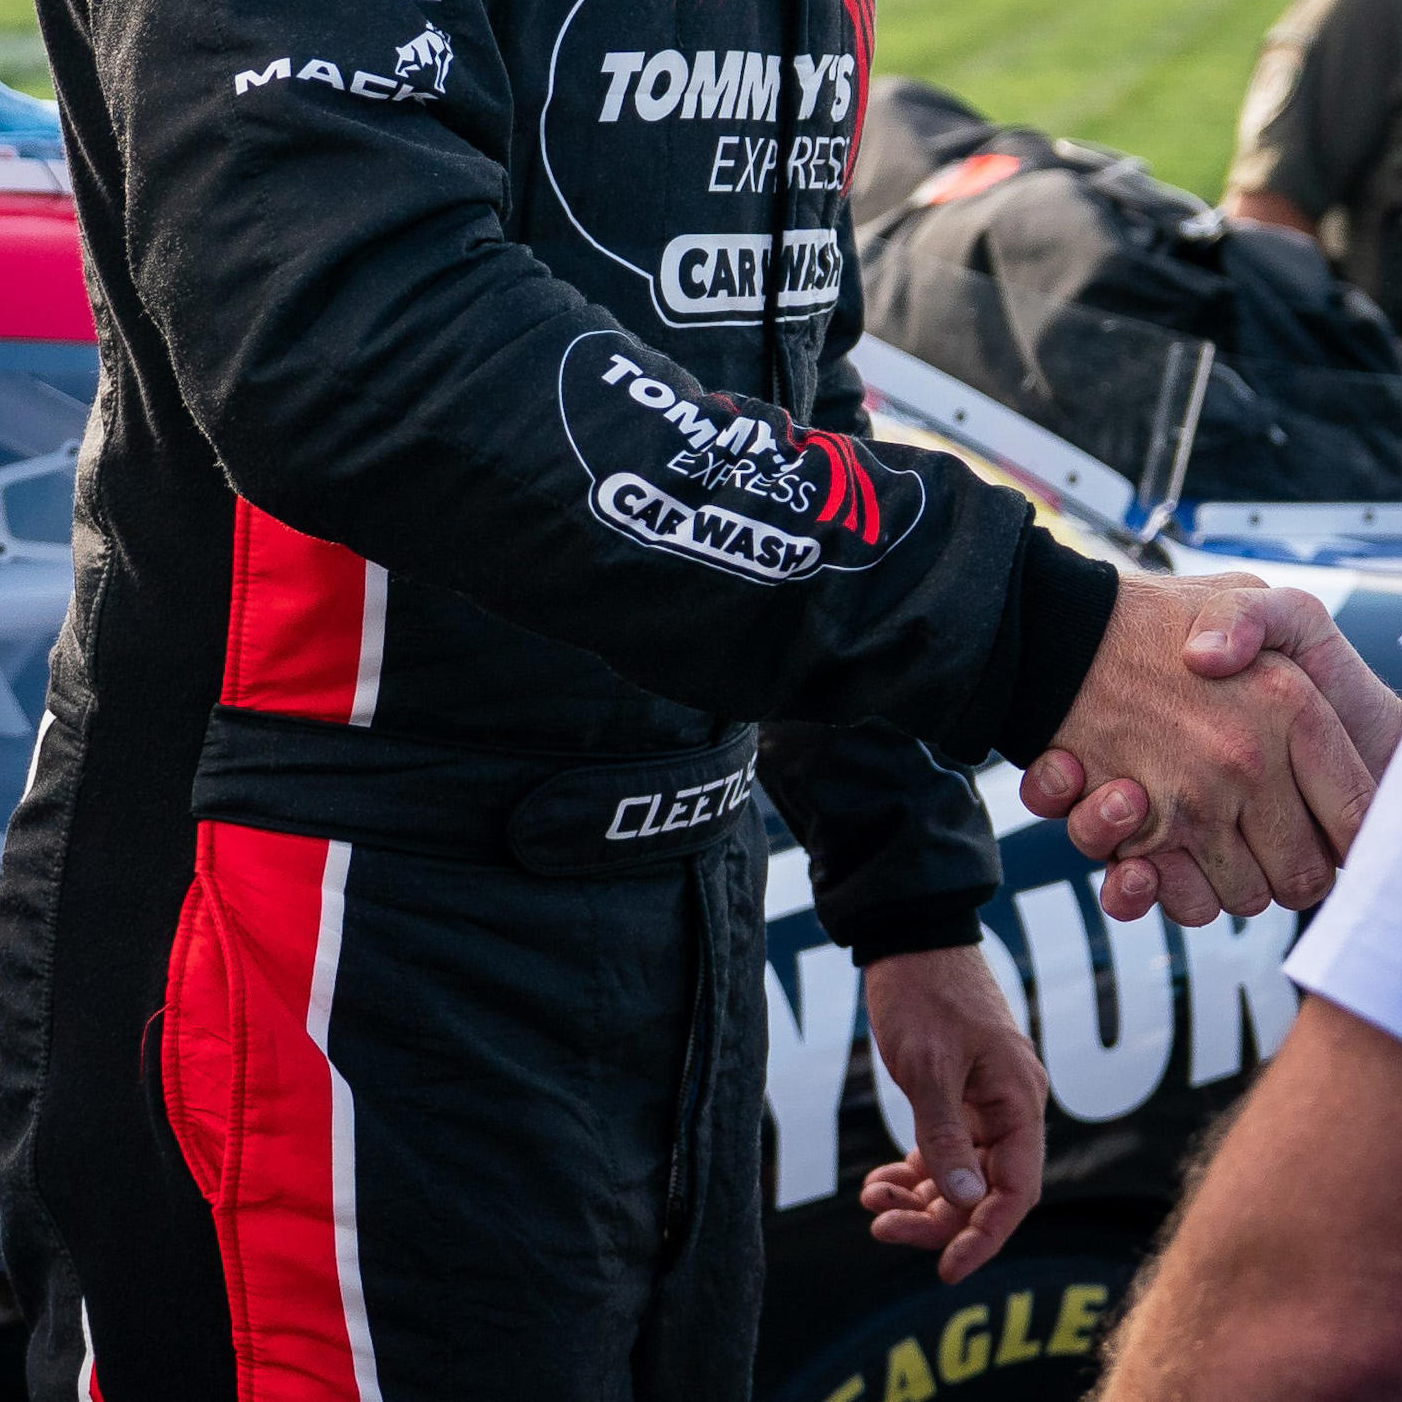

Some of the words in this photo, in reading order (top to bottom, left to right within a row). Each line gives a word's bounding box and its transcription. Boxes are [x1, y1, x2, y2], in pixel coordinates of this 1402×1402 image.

[599, 49, 854, 123] TOMMY'S
[678, 247, 761, 299] CAR
[612, 483, 688, 536] CAR
[694, 511, 814, 573] WASH
